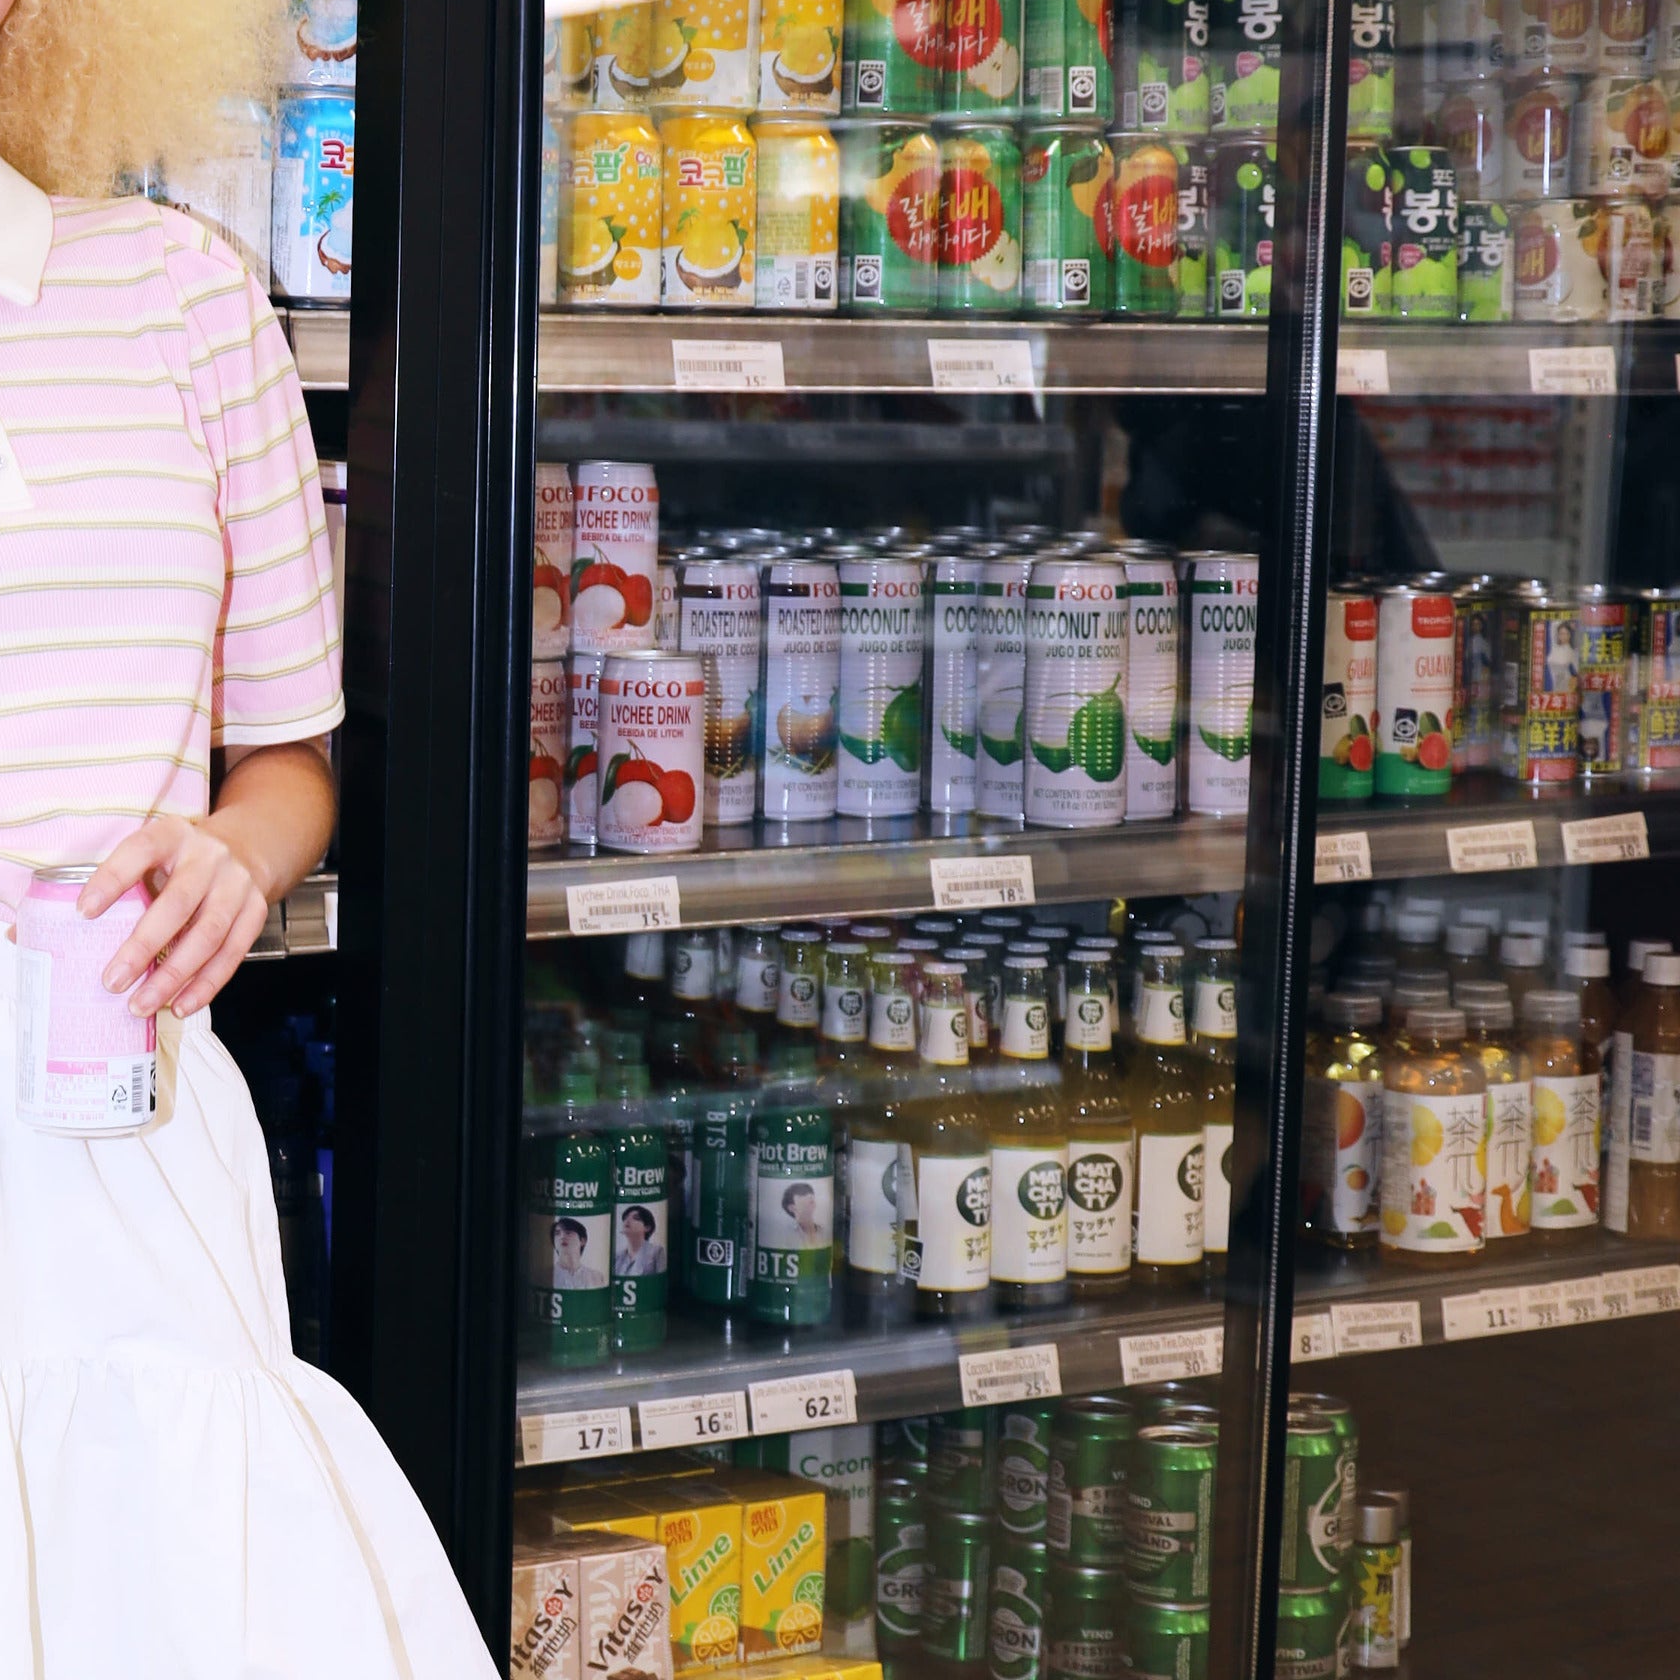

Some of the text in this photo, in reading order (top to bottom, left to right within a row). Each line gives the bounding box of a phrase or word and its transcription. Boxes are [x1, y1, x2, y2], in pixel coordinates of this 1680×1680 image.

[678, 147, 750, 192] 코코팜
[587, 486, 645, 504] FOCO
[575, 510, 652, 530] LYCHEE DRINK
[1058, 584, 1113, 601] FOCO
[690, 609, 736, 637] ROASTED
[778, 608, 821, 635] ROASTED
[840, 607, 910, 634] COCONUT
[1030, 612, 1100, 640] COCONUT
[783, 641, 810, 654] JUGO
[858, 640, 888, 653] JUGO
[1045, 644, 1076, 658] JUGO
[623, 680, 682, 699] FOCO
[610, 703, 691, 726] LYCHEE DRINK
[999, 888, 1016, 903] 18
[643, 912, 660, 927] 15
[706, 1110, 727, 1149] BTS
[757, 1142, 828, 1162] Hot Brew
[624, 1166, 665, 1185] Brew
[1029, 1169, 1062, 1186] MAT
[1075, 1162, 1116, 1178] MAT
[554, 1179, 599, 1199] Brew
[1028, 1186, 1064, 1202] CHA
[1074, 1178, 1117, 1194] CHA
[1036, 1202, 1059, 1217] TY
[1083, 1194, 1110, 1209] TY
[758, 1253, 799, 1278] BTS
[1488, 1308, 1507, 1328] 11
[1301, 1336, 1311, 1354] 8
[1185, 1359, 1201, 1375] 30
[1025, 1382, 1042, 1396] 25
[805, 1396, 831, 1418] 62
[694, 1413, 720, 1436] 16
[578, 1429, 604, 1451] 17
[753, 1521, 815, 1596] Lime
[1080, 1629, 1114, 1641] VIND
